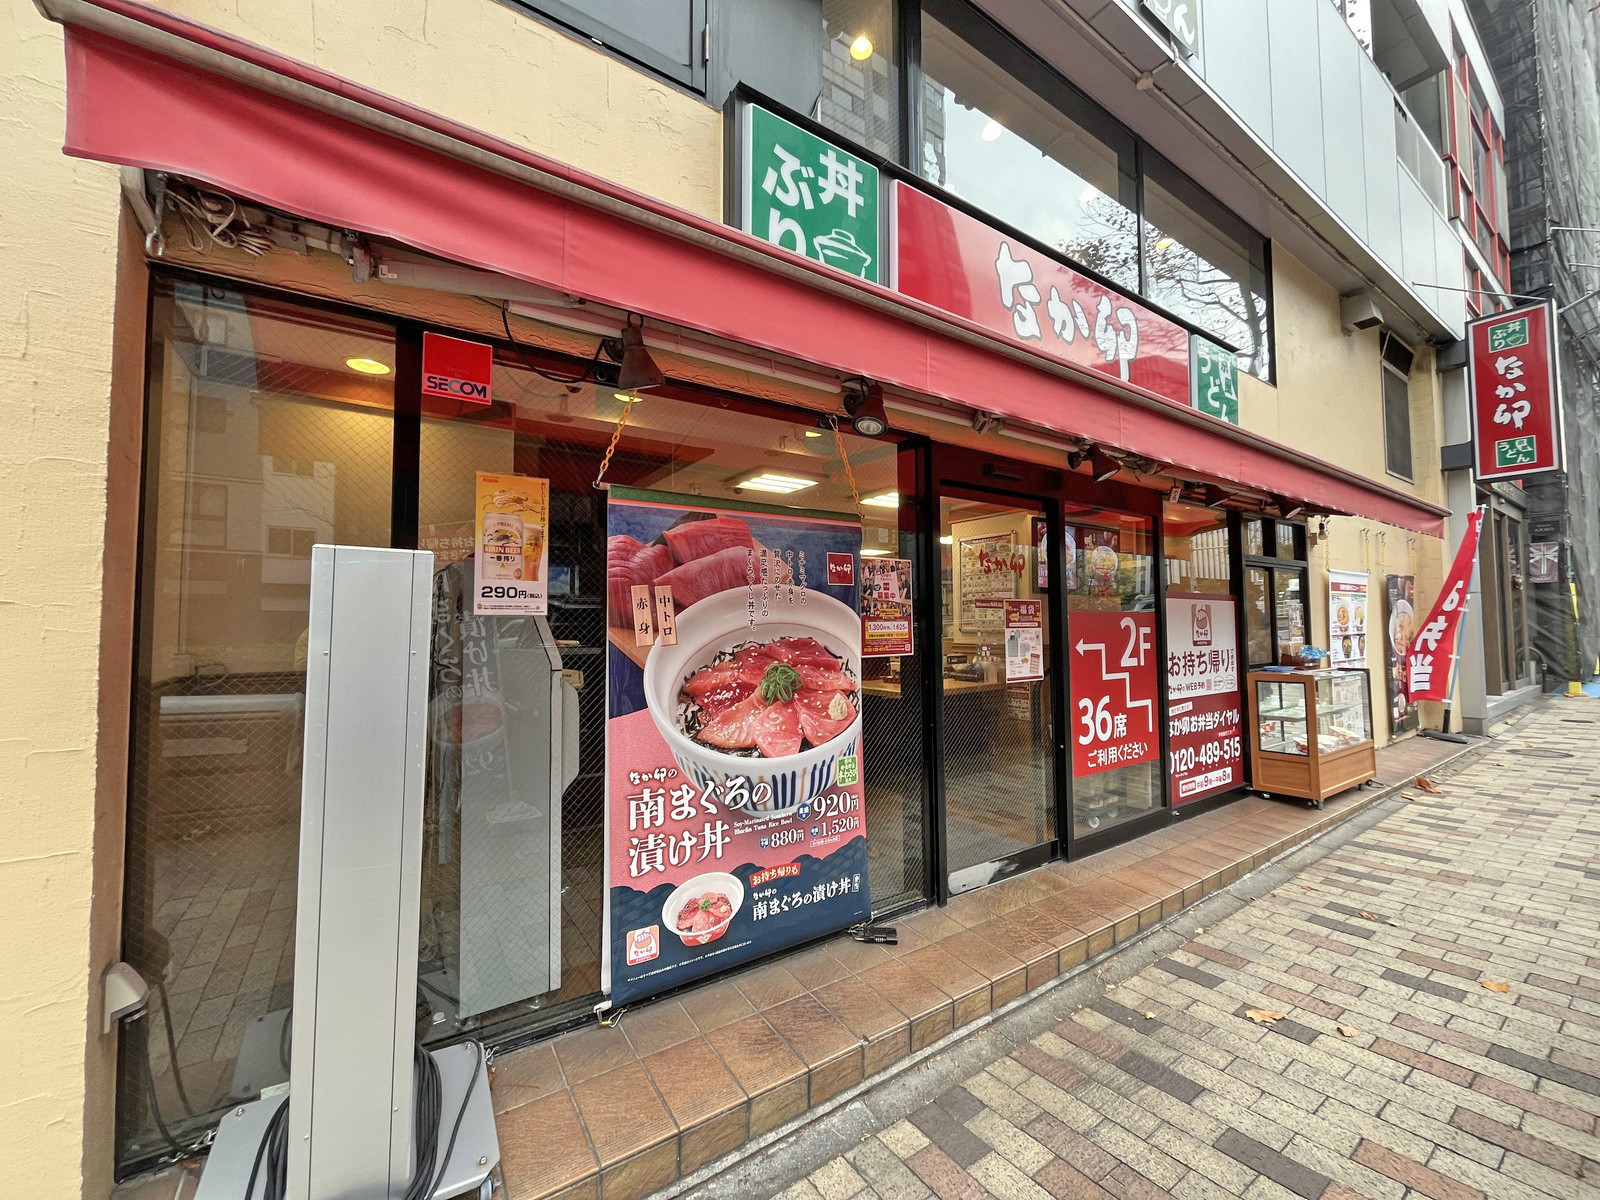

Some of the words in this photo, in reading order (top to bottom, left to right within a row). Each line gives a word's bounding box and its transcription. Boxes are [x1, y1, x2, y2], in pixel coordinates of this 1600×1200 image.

[995, 240, 1139, 384] なか卯
[427, 375, 487, 399] SECOM
[1493, 355, 1531, 430] なか卯
[829, 562, 852, 574] なか卯
[978, 549, 1026, 579] なか卯
[636, 597, 651, 636] 赤身
[659, 595, 673, 636] 中トロ
[1020, 604, 1035, 615] 福袋
[1120, 616, 1151, 667] 2F
[1168, 648, 1230, 677] お持ち帰り
[1078, 695, 1128, 746] 36席
[1087, 742, 1149, 768] ご利用ください
[629, 768, 678, 784] なか卯の
[626, 776, 772, 831] 南まぐろの
[813, 791, 859, 821] 920円
[628, 820, 731, 878] 漬け丼
[771, 828, 805, 848] 880円
[752, 864, 799, 886] お持ち帰りも
[753, 877, 852, 921] 南まぐろの漬け丼
